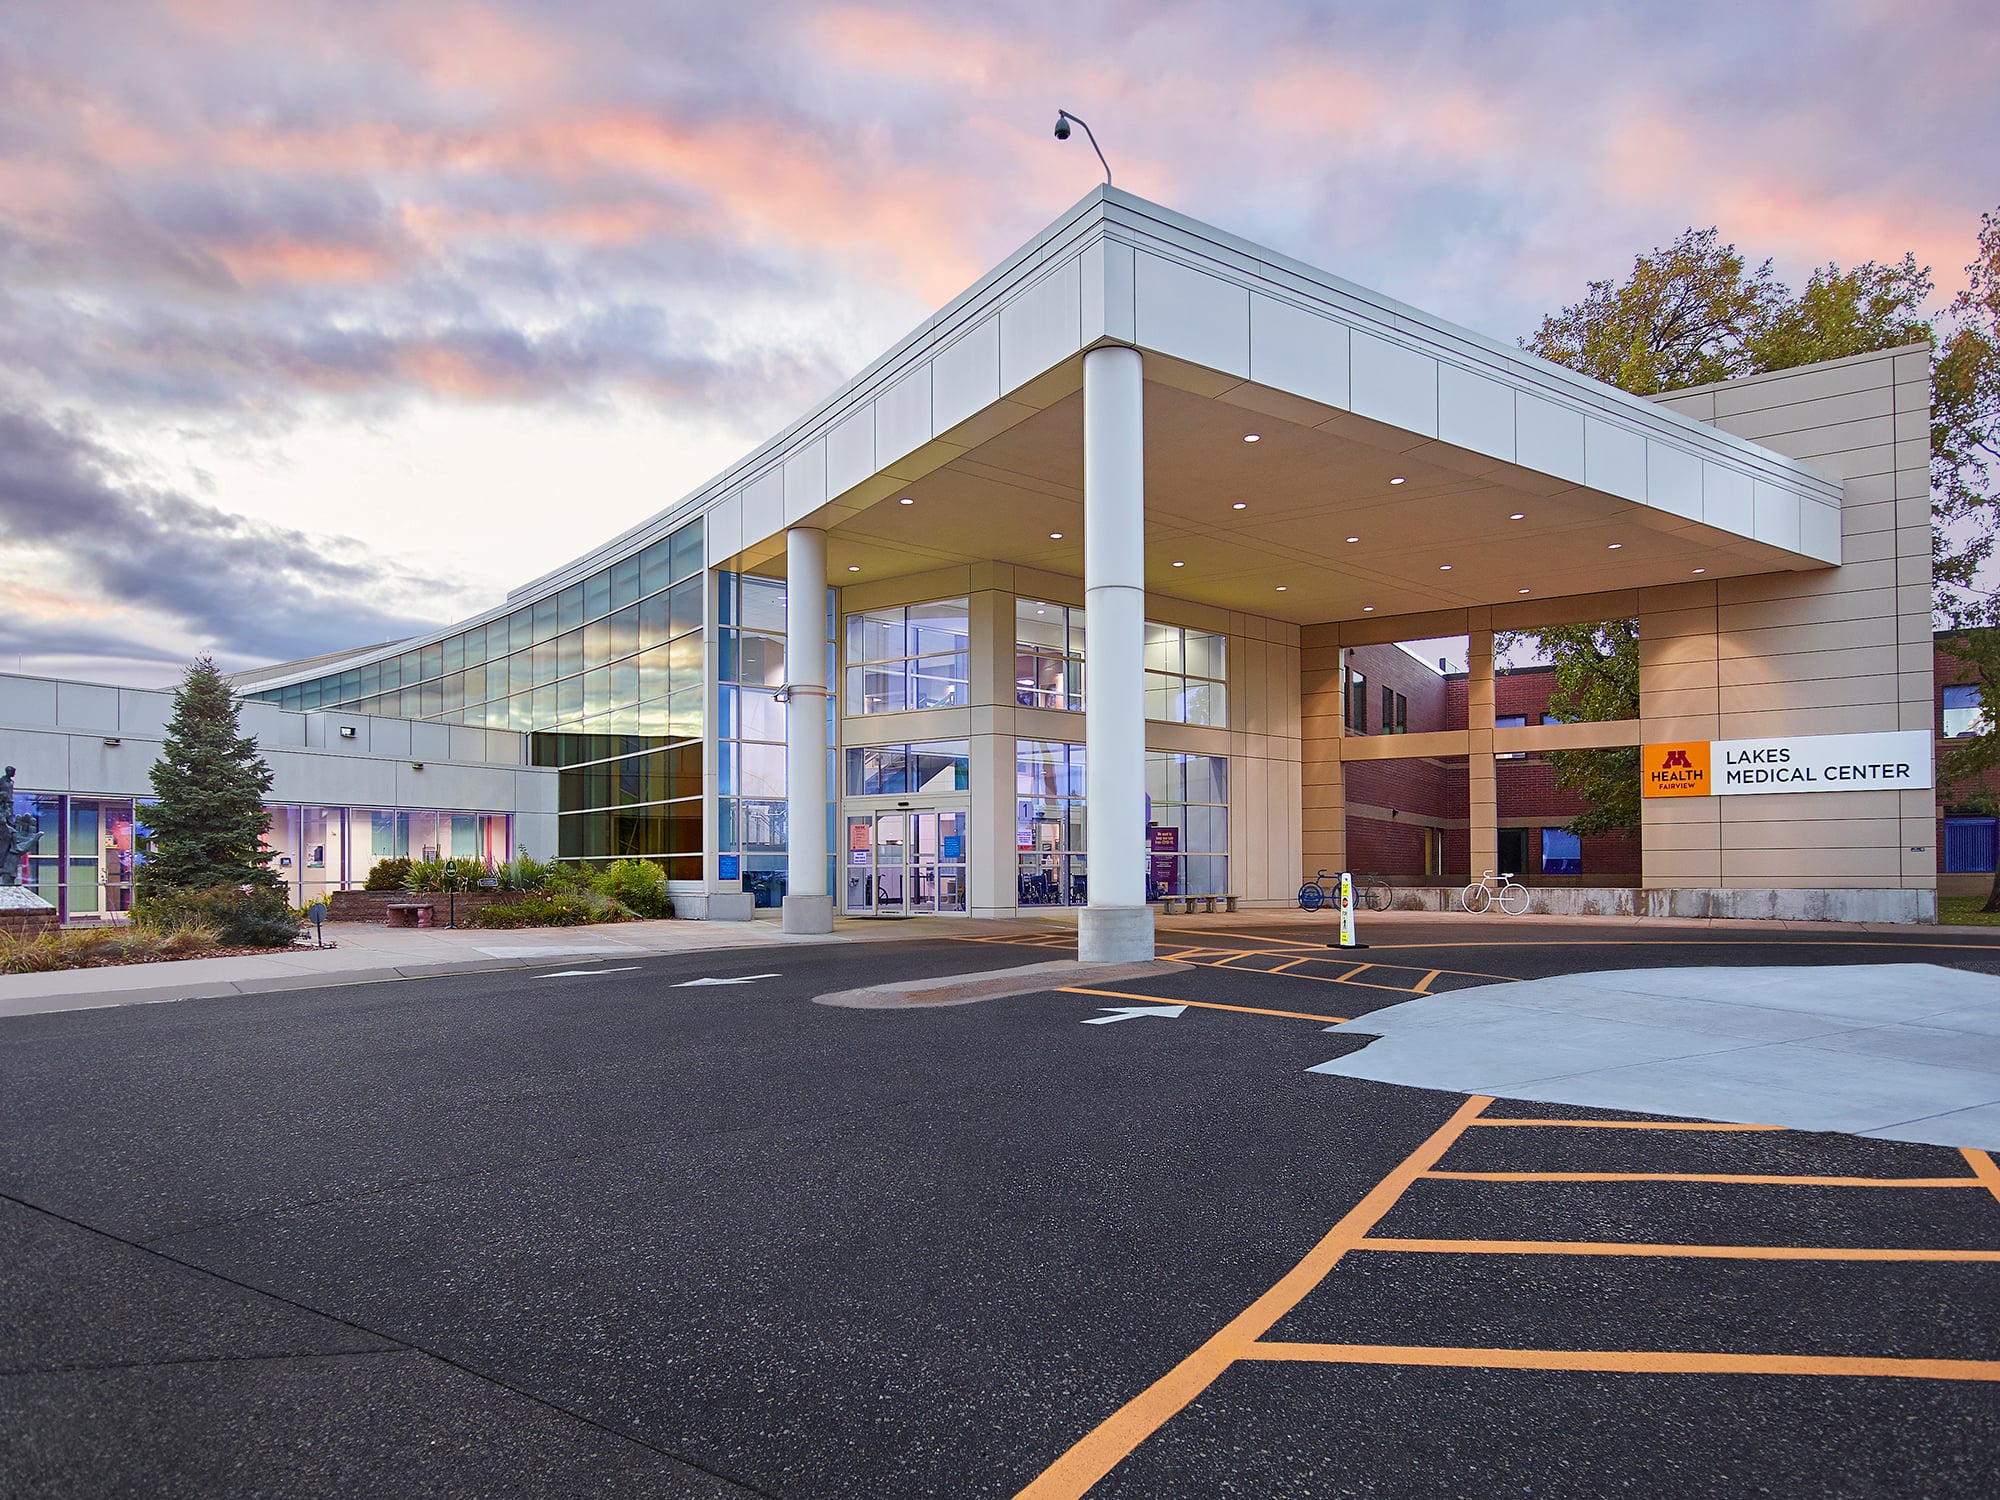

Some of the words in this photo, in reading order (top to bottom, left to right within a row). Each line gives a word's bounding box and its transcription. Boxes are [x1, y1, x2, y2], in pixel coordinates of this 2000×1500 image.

[1726, 748, 1791, 765] LAKES
[1651, 769, 1703, 782] HEALTH
[1727, 767, 1817, 784] MEDICAL
[1823, 763, 1911, 781] CENTER
[1659, 782, 1696, 790] FAIRVIEW
[1023, 803, 1028, 818] 1
